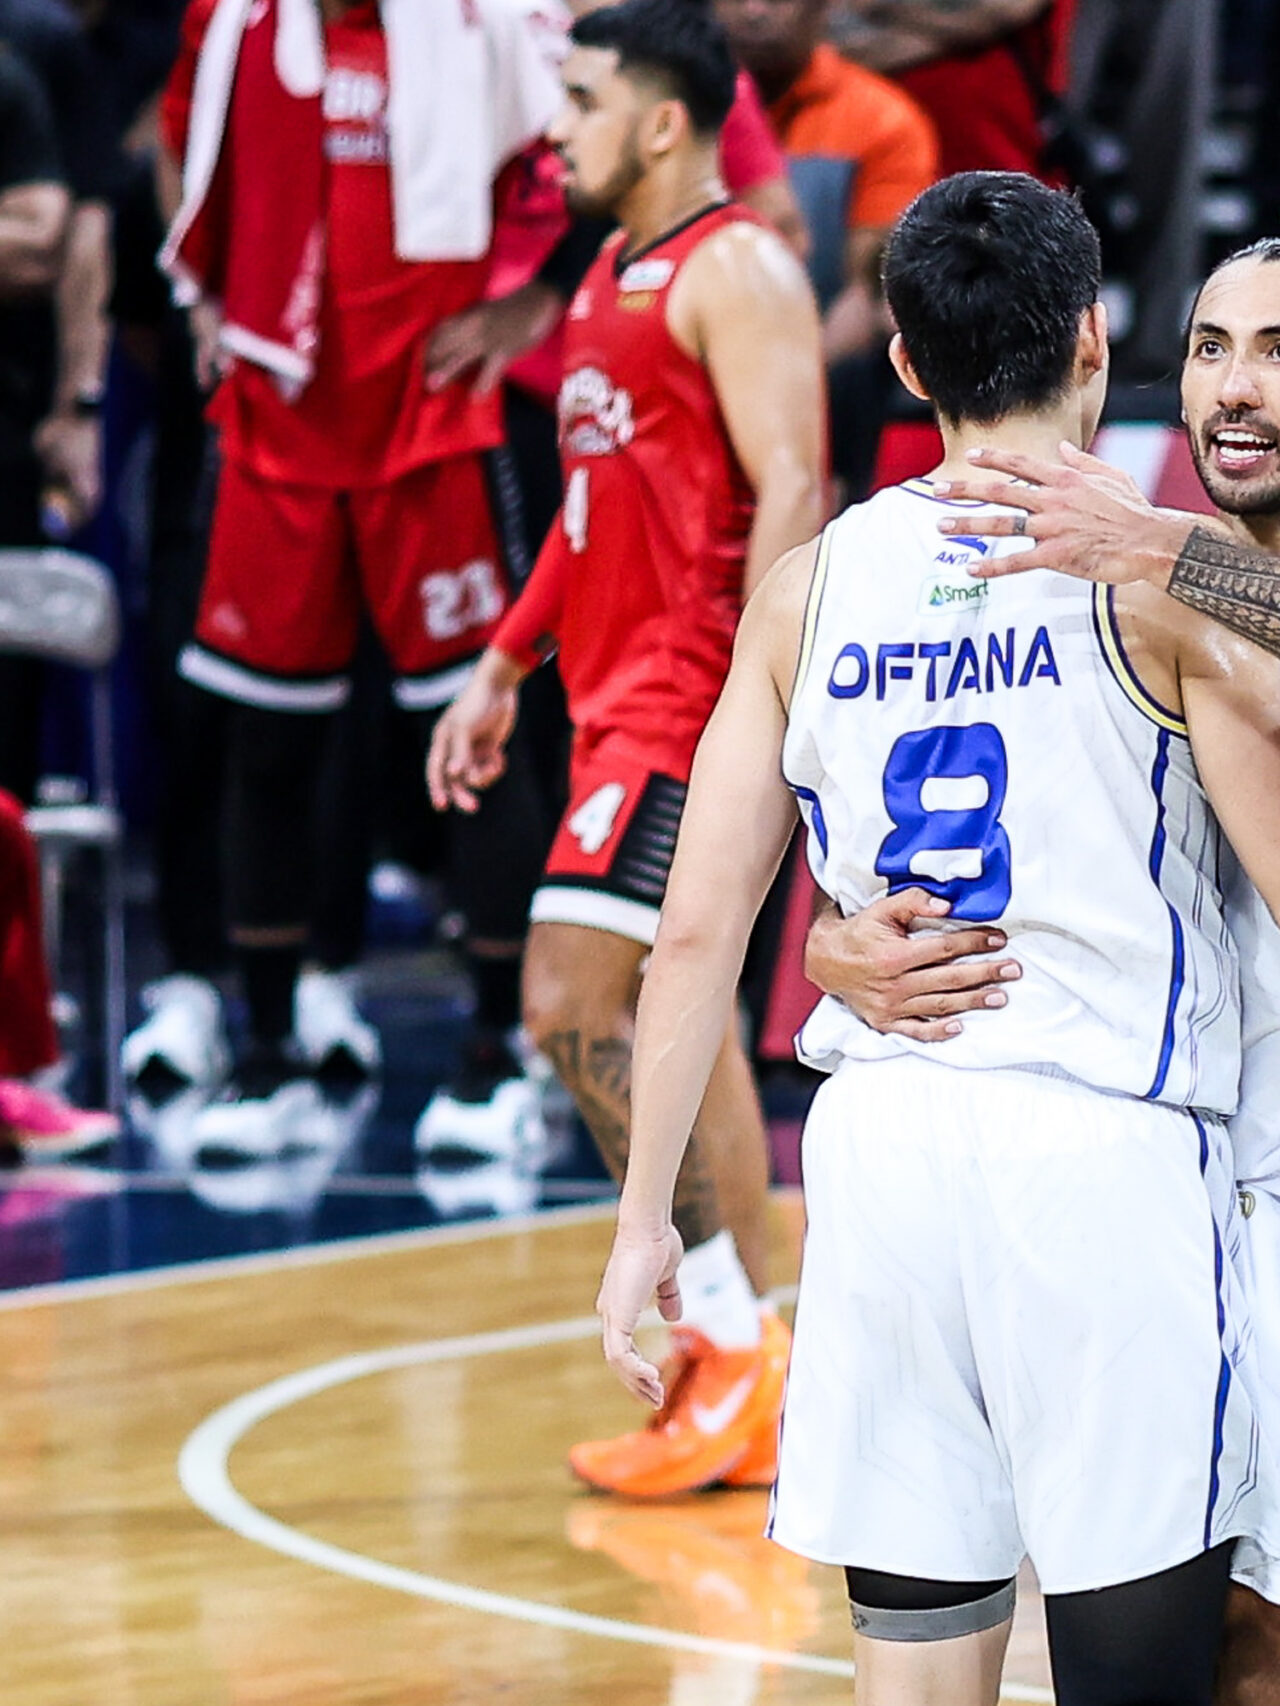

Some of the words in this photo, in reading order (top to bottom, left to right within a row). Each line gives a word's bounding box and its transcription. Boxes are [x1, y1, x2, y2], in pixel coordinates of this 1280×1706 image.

[944, 577, 989, 602] Smart
[827, 625, 1062, 702] OFTANA
[569, 782, 627, 855] 4
[874, 721, 1012, 923] 8
